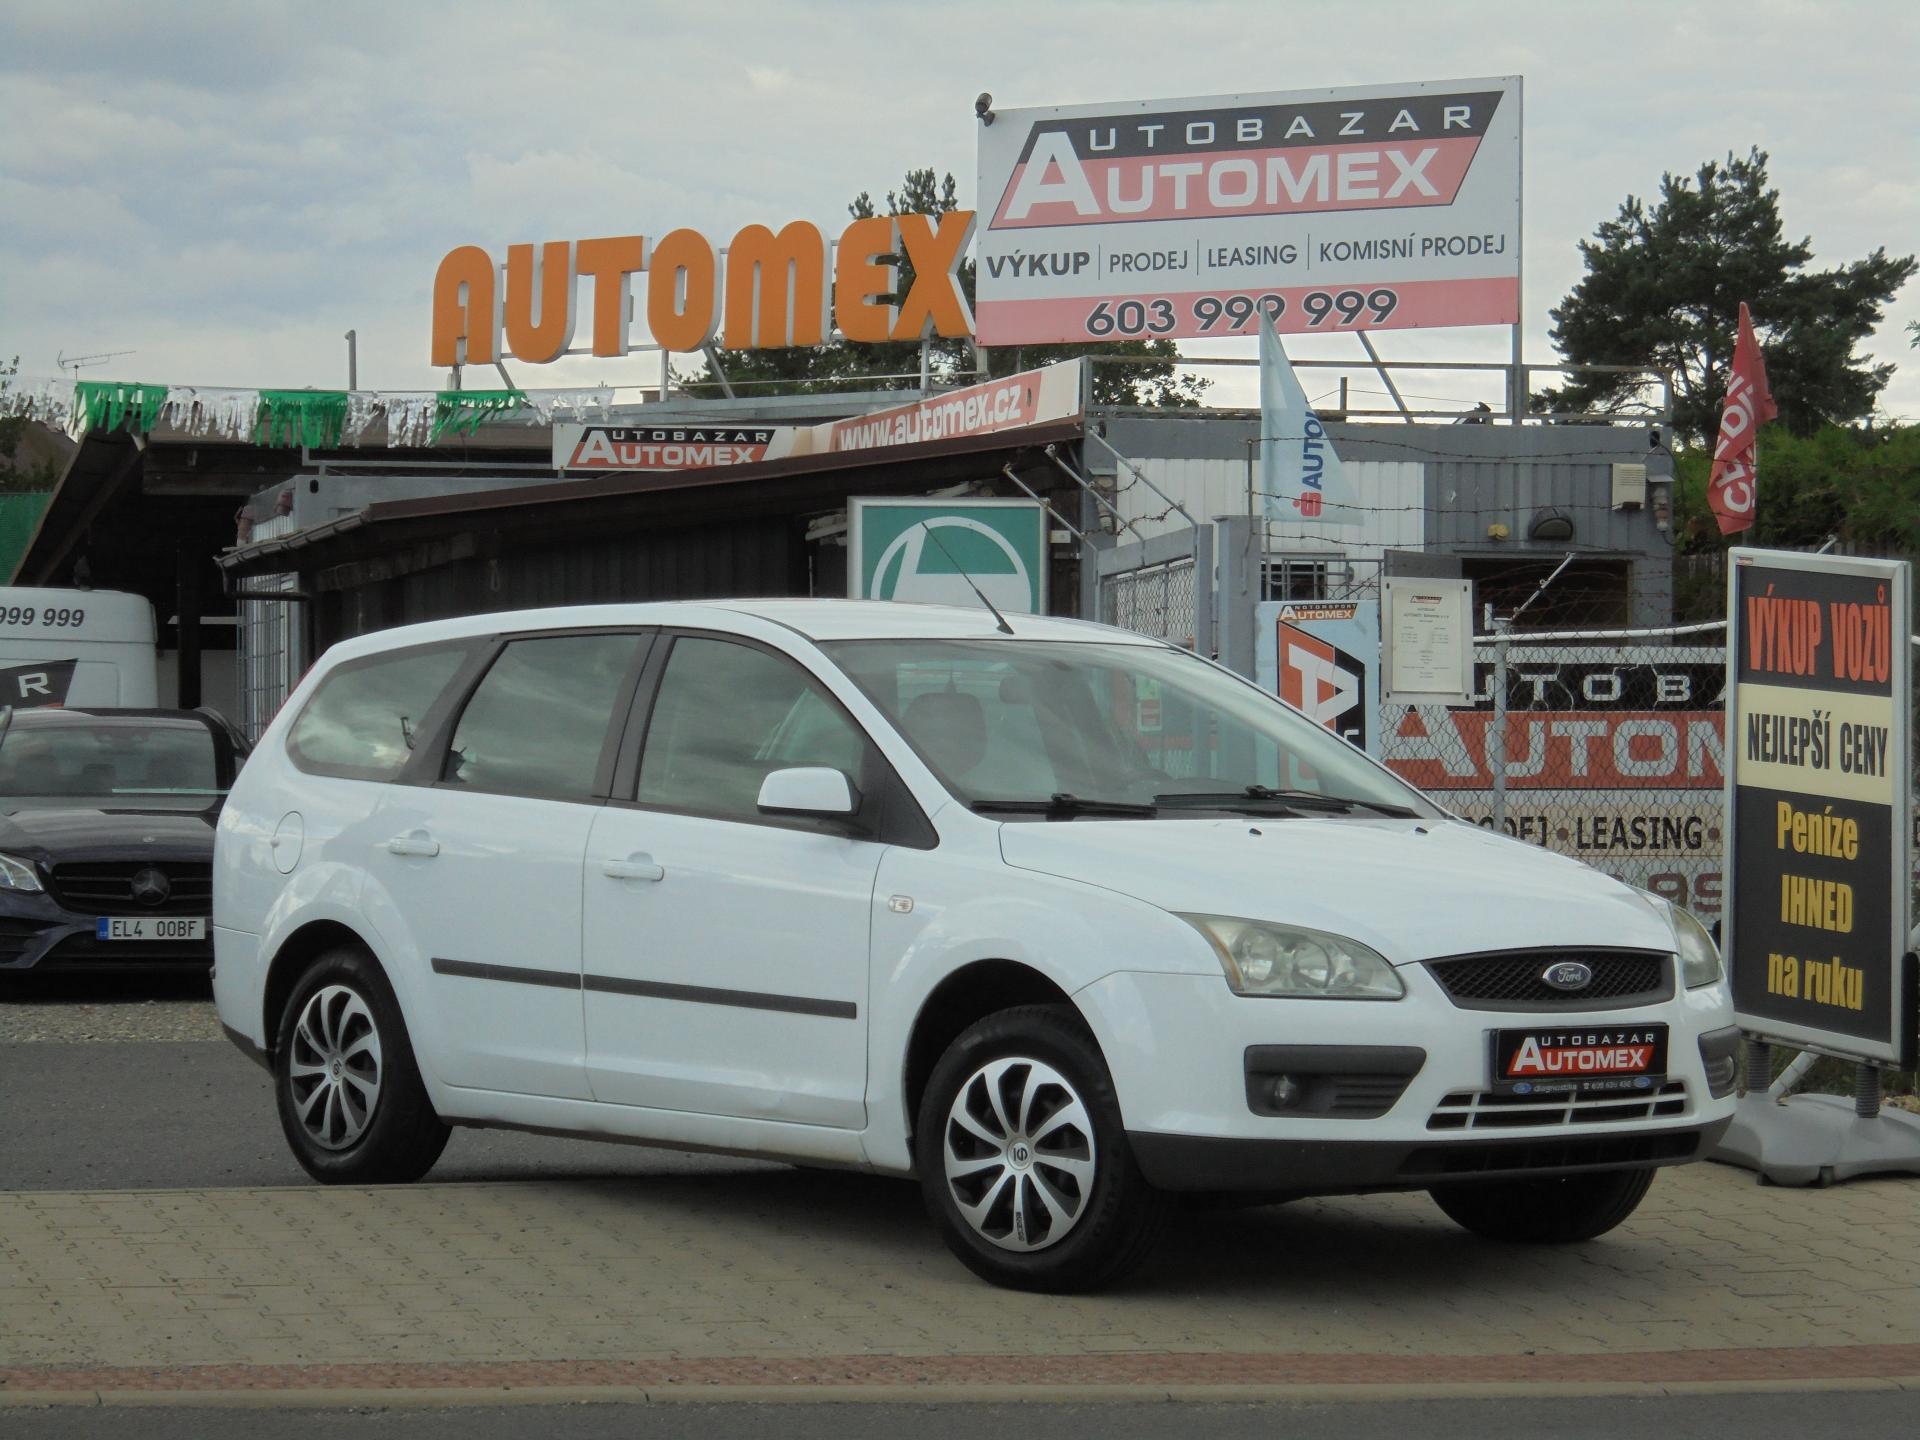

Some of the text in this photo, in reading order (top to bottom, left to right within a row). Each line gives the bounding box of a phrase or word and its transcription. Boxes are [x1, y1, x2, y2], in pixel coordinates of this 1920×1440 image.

[1003, 132, 1440, 220] AUTOMEX
[986, 232, 1506, 279] VÝKUP PRODEJ LEASING KOMISNÍ PRODEJ
[431, 210, 975, 367] AUTOMEX
[1086, 289, 1398, 337] 603 999 999
[841, 384, 1022, 450] www.automex.cz
[577, 431, 755, 466] AUTOMEX
[1301, 411, 1325, 491] AUTO
[42, 608, 85, 627] 999
[1280, 605, 1352, 621] AUTOMEX
[1747, 583, 1890, 684] VÝKUP VOZŮ
[1747, 709, 1889, 779] NEJLEPŠÍ CENY
[1577, 815, 1702, 850] LEASING
[1777, 801, 1859, 861] Peníze
[112, 920, 143, 937] EL4
[1781, 873, 1854, 934] IHNED
[1558, 967, 1582, 983] Ford
[1767, 952, 1864, 1012] na ruku
[1513, 1037, 1645, 1072] AUTOMEX
